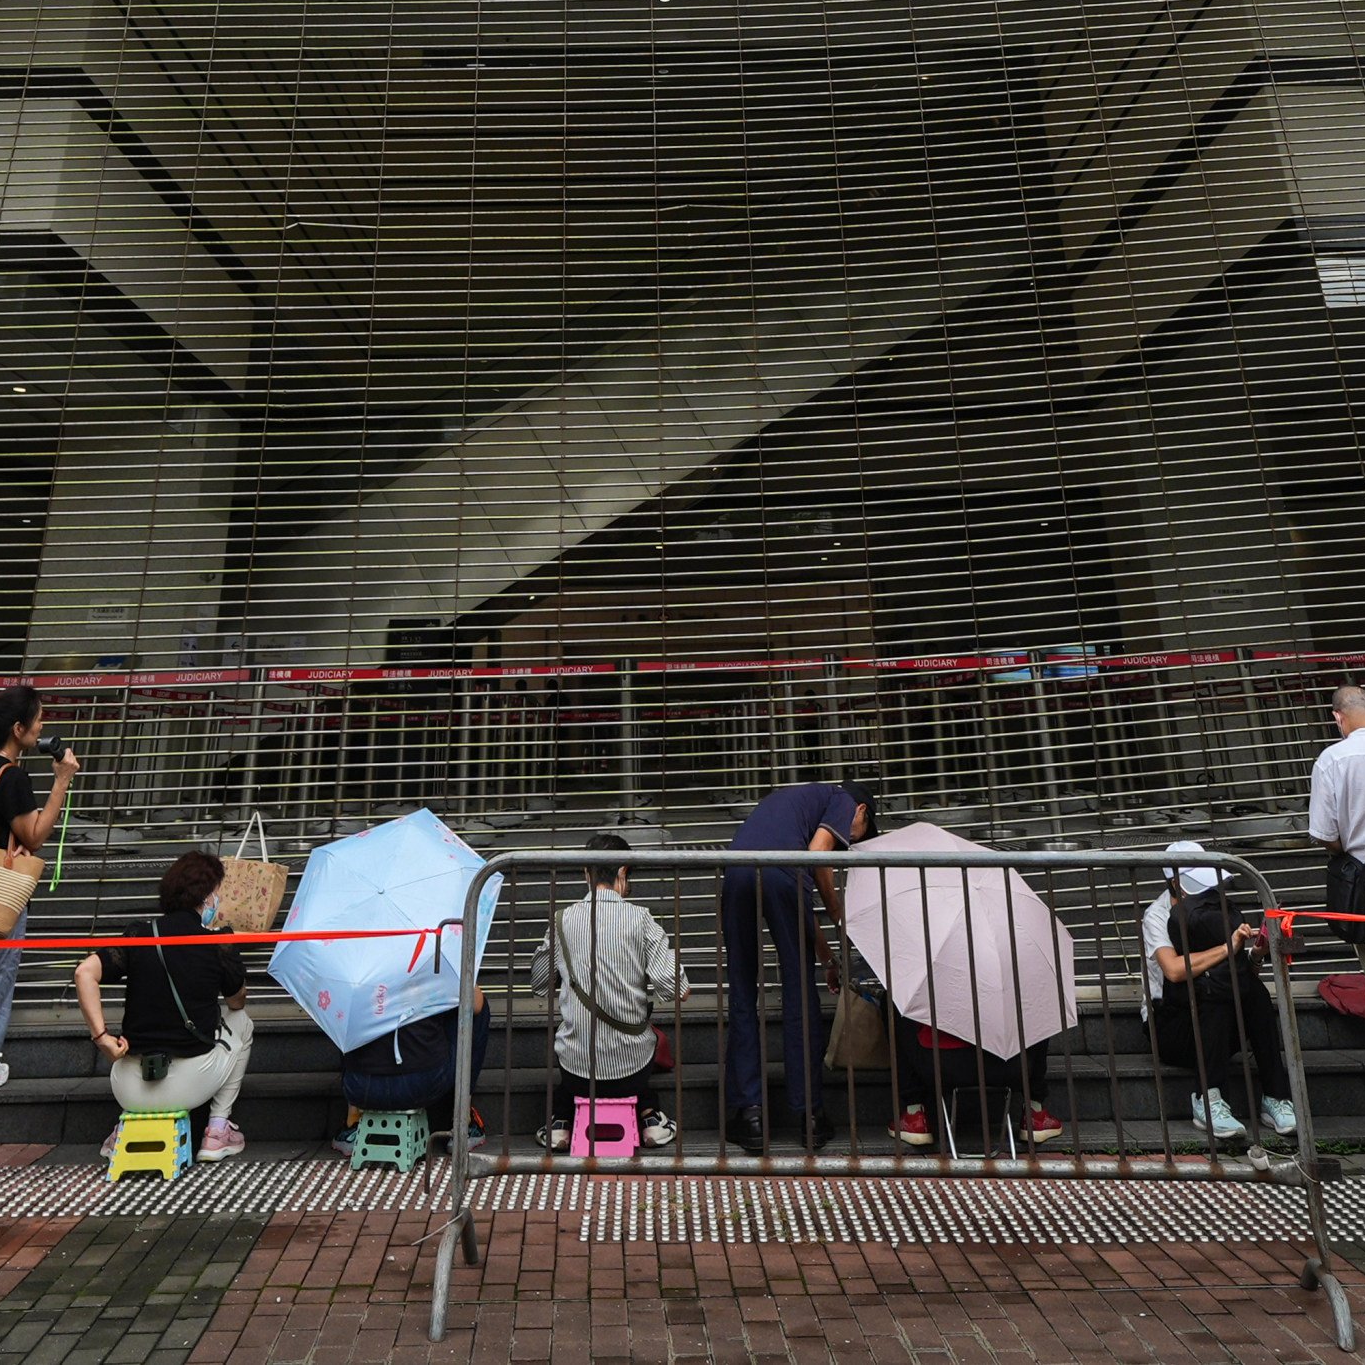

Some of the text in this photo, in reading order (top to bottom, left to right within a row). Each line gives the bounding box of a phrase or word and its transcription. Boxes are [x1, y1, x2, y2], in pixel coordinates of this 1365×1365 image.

[913, 658, 958, 668] JUDICIARY
[985, 656, 1016, 666] 司法機構
[1122, 655, 1168, 665] JUDICIARY
[54, 676, 102, 686] JUDICIARY
[175, 671, 223, 682] JUDICIARY
[268, 669, 292, 679] 法機構
[307, 669, 354, 679] JUDICIARY
[428, 668, 474, 678] JUDICIARY
[374, 984, 388, 1015] lucky
